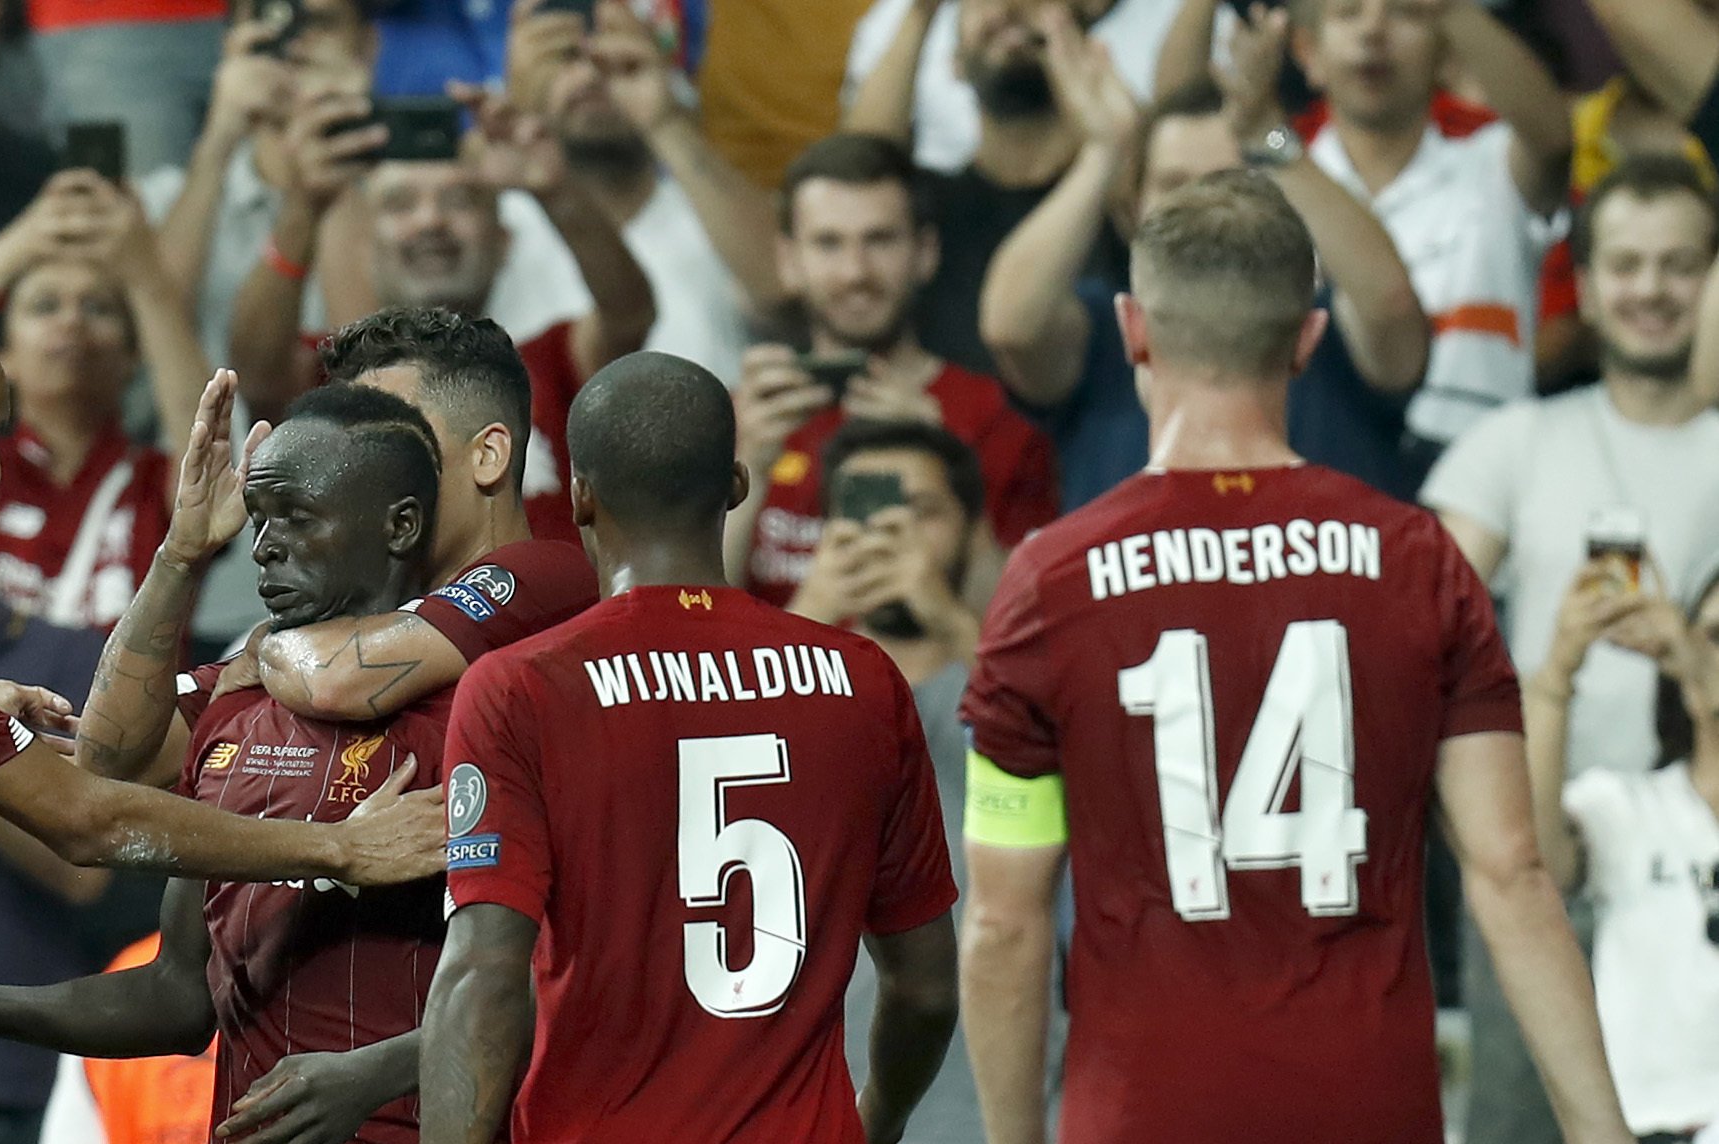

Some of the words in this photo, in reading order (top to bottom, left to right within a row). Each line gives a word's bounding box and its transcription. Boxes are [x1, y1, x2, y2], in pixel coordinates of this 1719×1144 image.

[1086, 518, 1381, 601] HENDERSON
[584, 644, 854, 708] WIJNALDUM
[250, 745, 271, 755] UEFA
[1117, 618, 1369, 921] 14
[453, 799, 466, 818] 6
[447, 842, 499, 862] ESPECT
[678, 733, 806, 1019] 5
